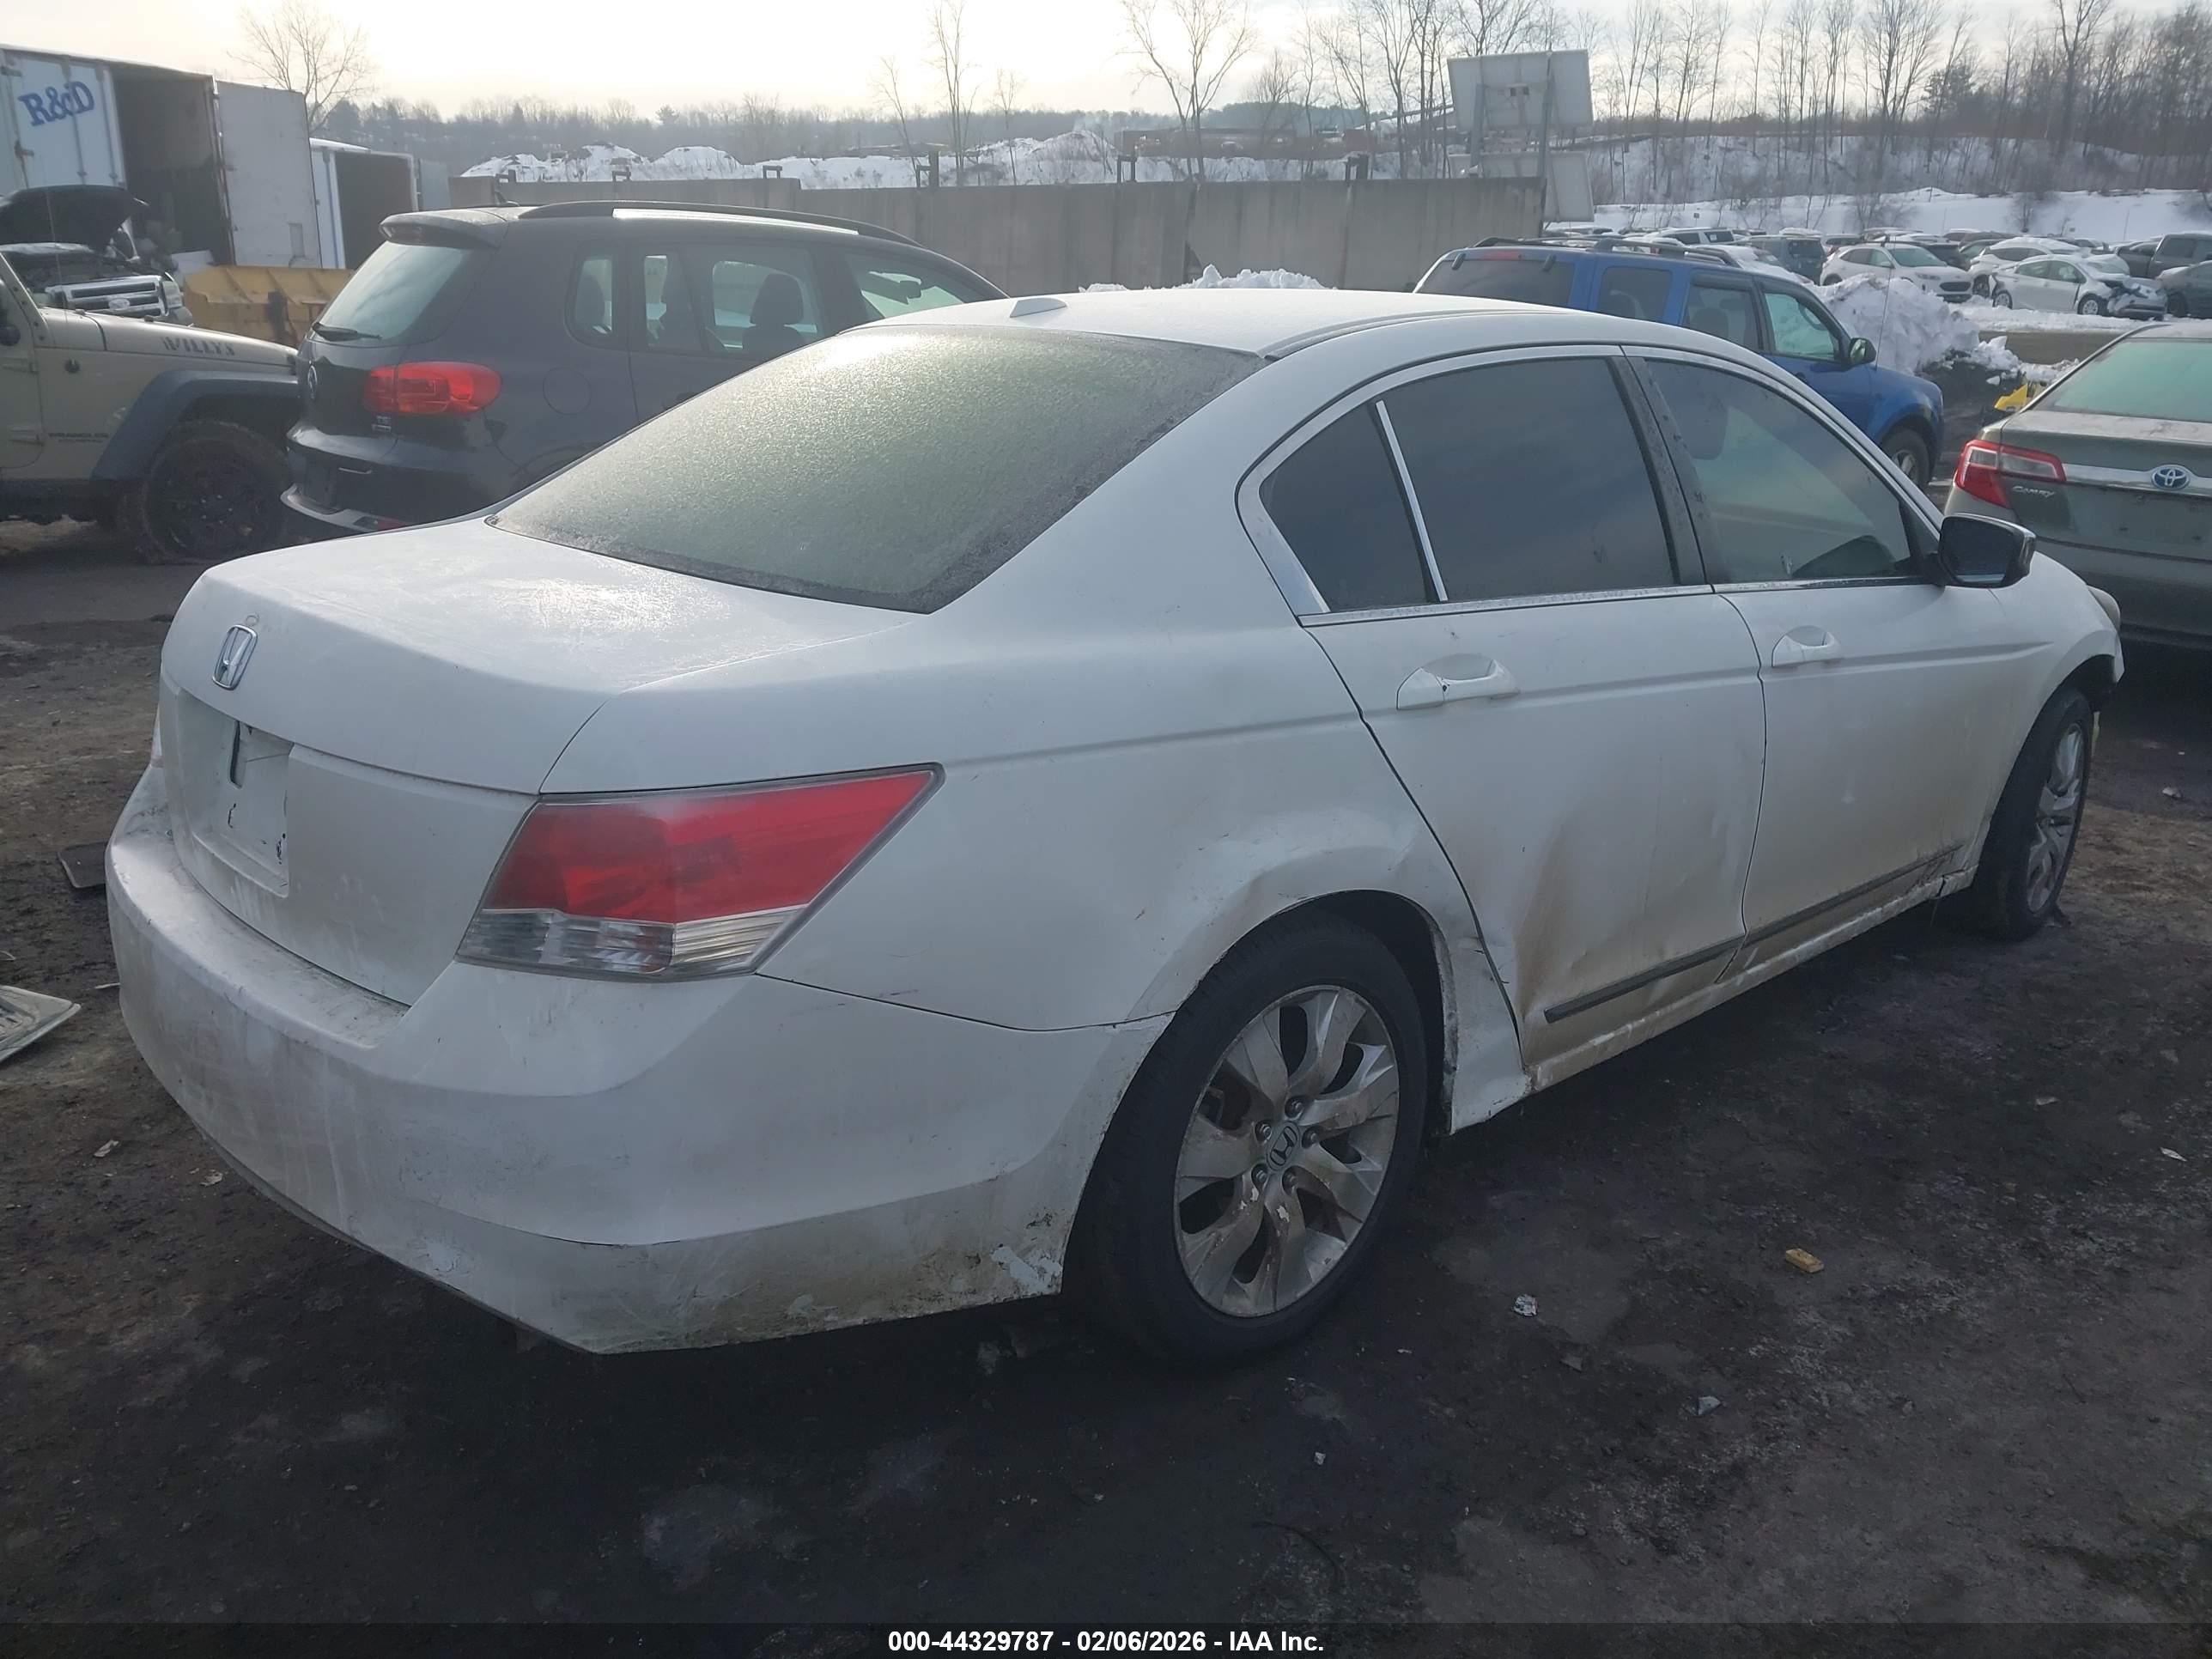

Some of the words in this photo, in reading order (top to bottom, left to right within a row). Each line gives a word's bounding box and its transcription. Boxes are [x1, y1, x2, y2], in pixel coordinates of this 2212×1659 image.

[17, 81, 94, 126] R&D
[161, 336, 234, 356] WILLYS
[2012, 485, 2055, 498] CAMRY
